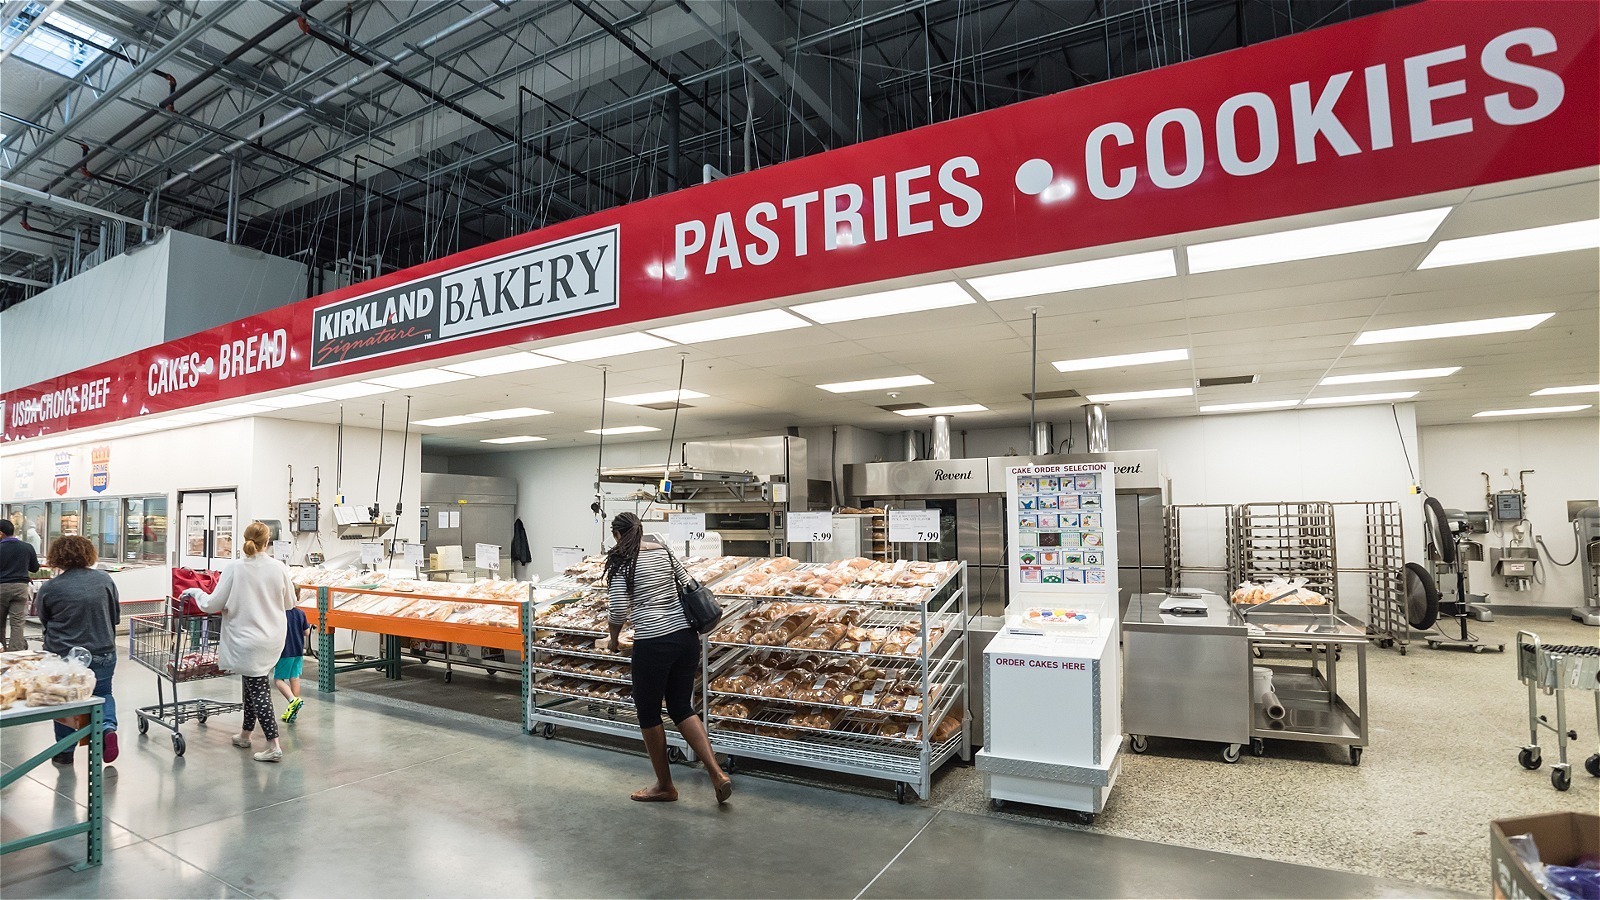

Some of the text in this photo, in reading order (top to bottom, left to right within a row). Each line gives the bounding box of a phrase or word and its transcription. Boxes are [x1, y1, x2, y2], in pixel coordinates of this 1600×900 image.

[673, 26, 1566, 281] PASTRIES COOKIES
[443, 244, 609, 327] BAKERY
[319, 287, 434, 341] KIRKLAND
[316, 325, 432, 363] Signature
[148, 328, 287, 397] CAKES BREAD
[12, 376, 111, 428] USDA CHOICE BEEF
[92, 463, 108, 472] PRIME
[1011, 464, 1107, 475] CAKE ORDER SELECTION
[1114, 463, 1141, 474] vent
[934, 468, 972, 481] Revent
[689, 531, 705, 540] 7.99
[812, 532, 832, 541] 5.99
[917, 531, 939, 541] 7.99
[995, 657, 1086, 671] ORDER CAKES HERE
